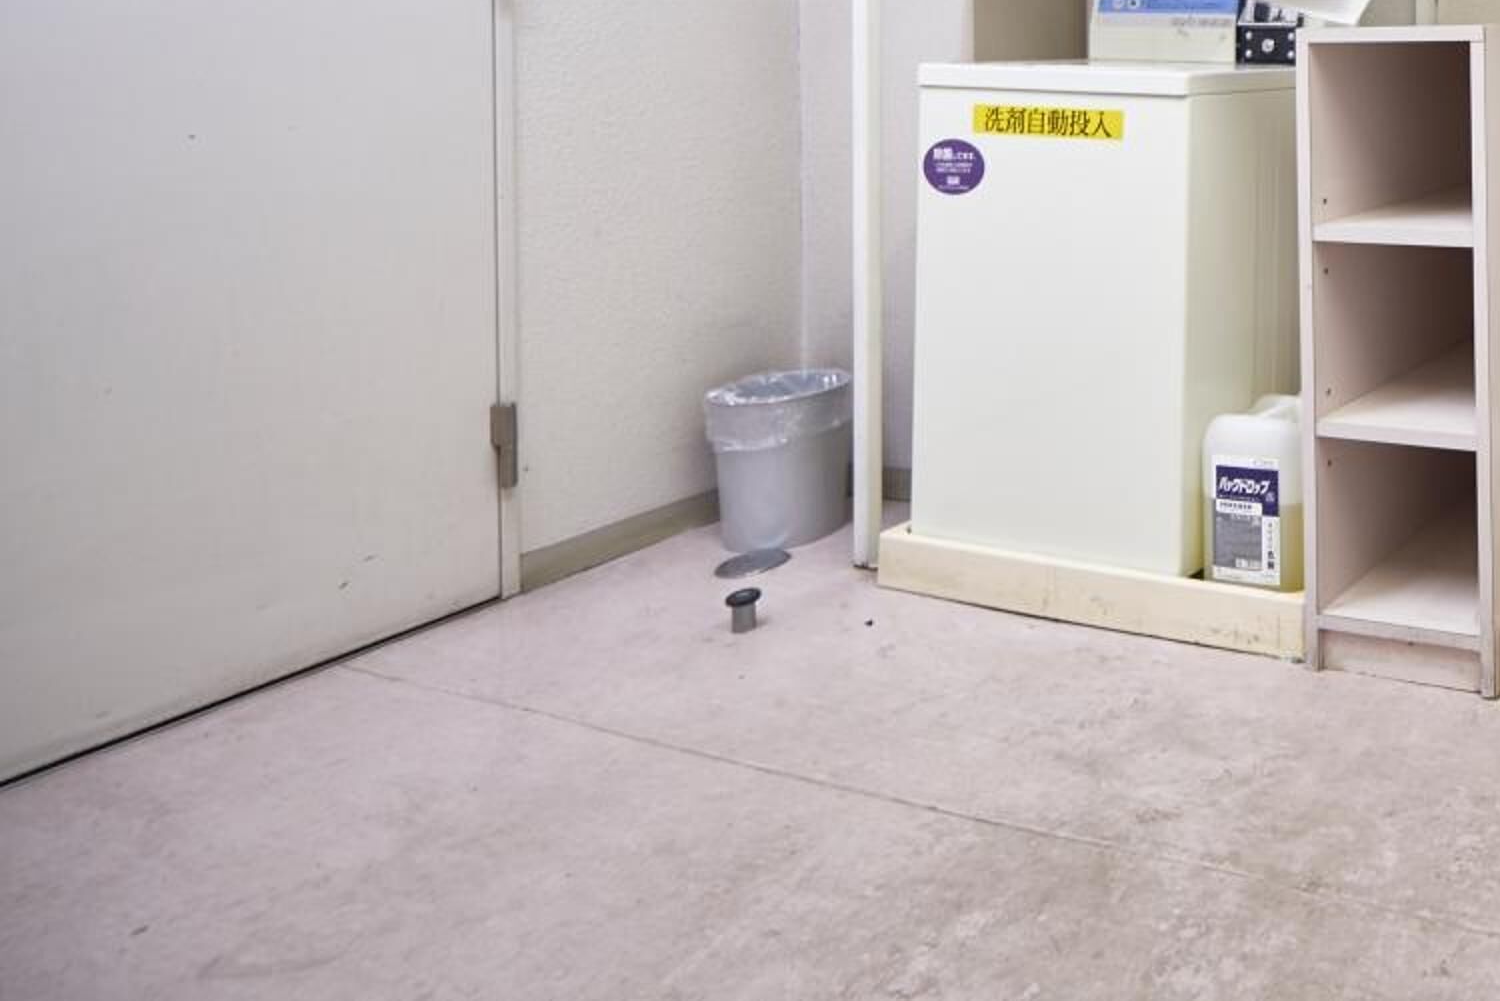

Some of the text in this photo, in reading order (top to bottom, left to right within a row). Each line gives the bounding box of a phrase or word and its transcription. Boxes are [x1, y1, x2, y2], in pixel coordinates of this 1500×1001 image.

[984, 105, 1112, 139] 洗剤自動投入
